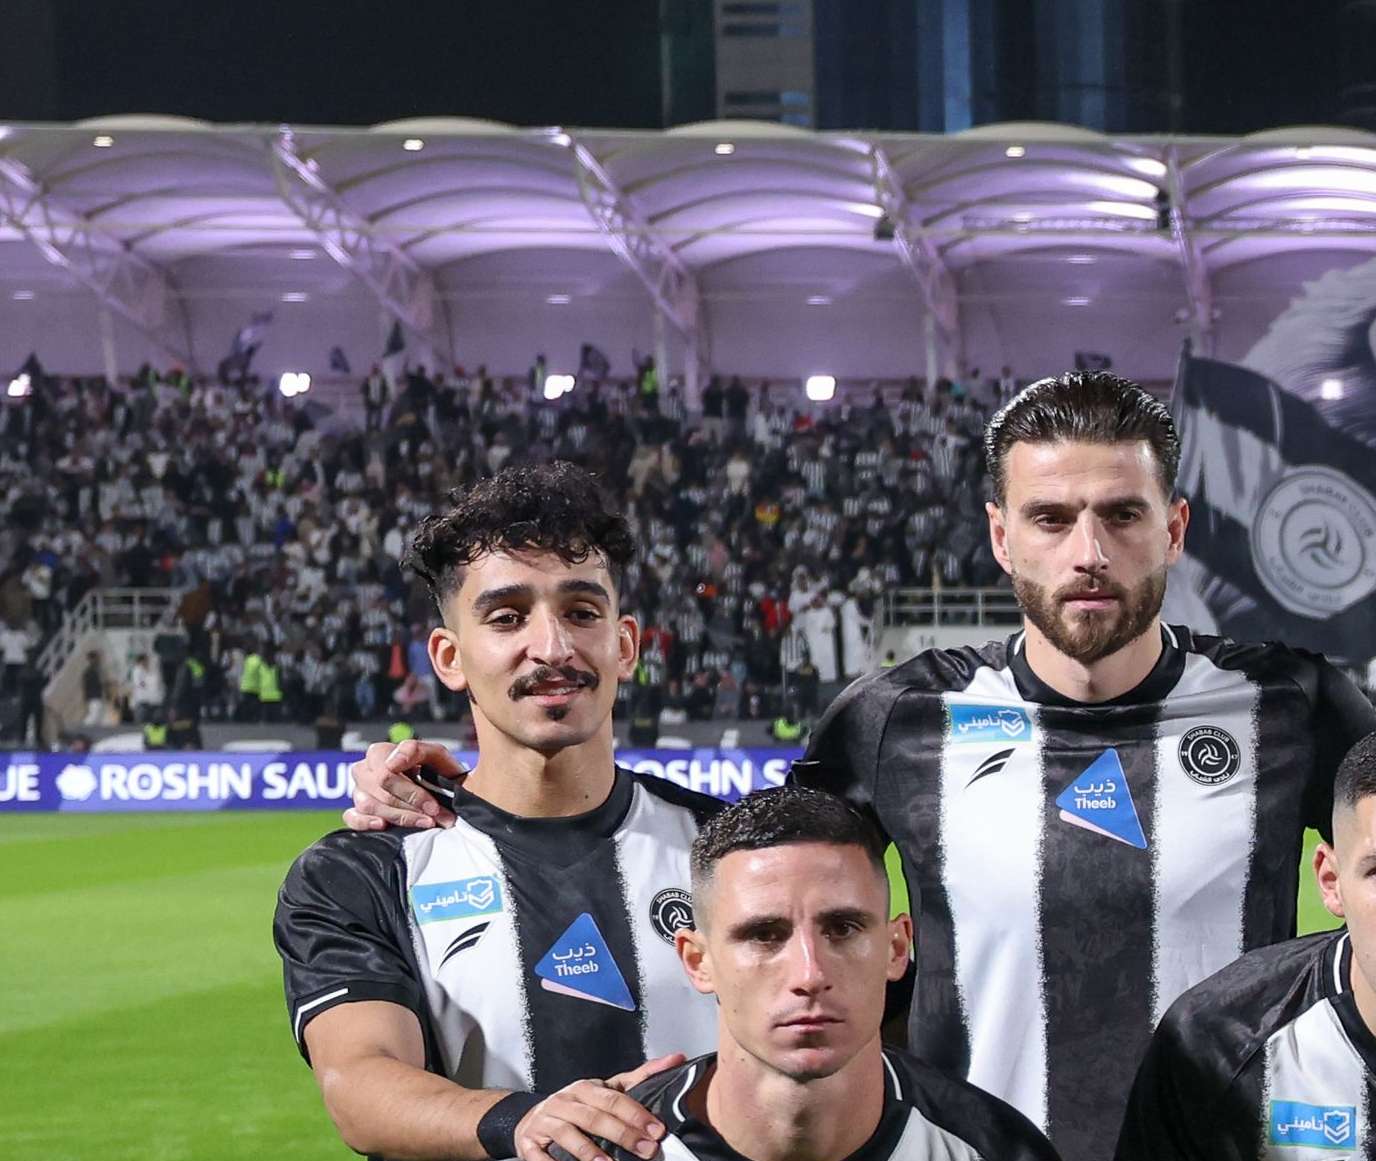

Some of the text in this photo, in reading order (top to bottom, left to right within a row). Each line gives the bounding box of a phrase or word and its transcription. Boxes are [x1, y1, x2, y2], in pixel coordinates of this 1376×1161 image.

[1187, 729, 1230, 743] SHABAB CLUB
[103, 762, 354, 800] ROSHN SAU
[1074, 779, 1116, 797] ذيب
[1074, 796, 1117, 809] Theeb
[552, 942, 596, 963] ذيب
[554, 961, 599, 977] Theeb
